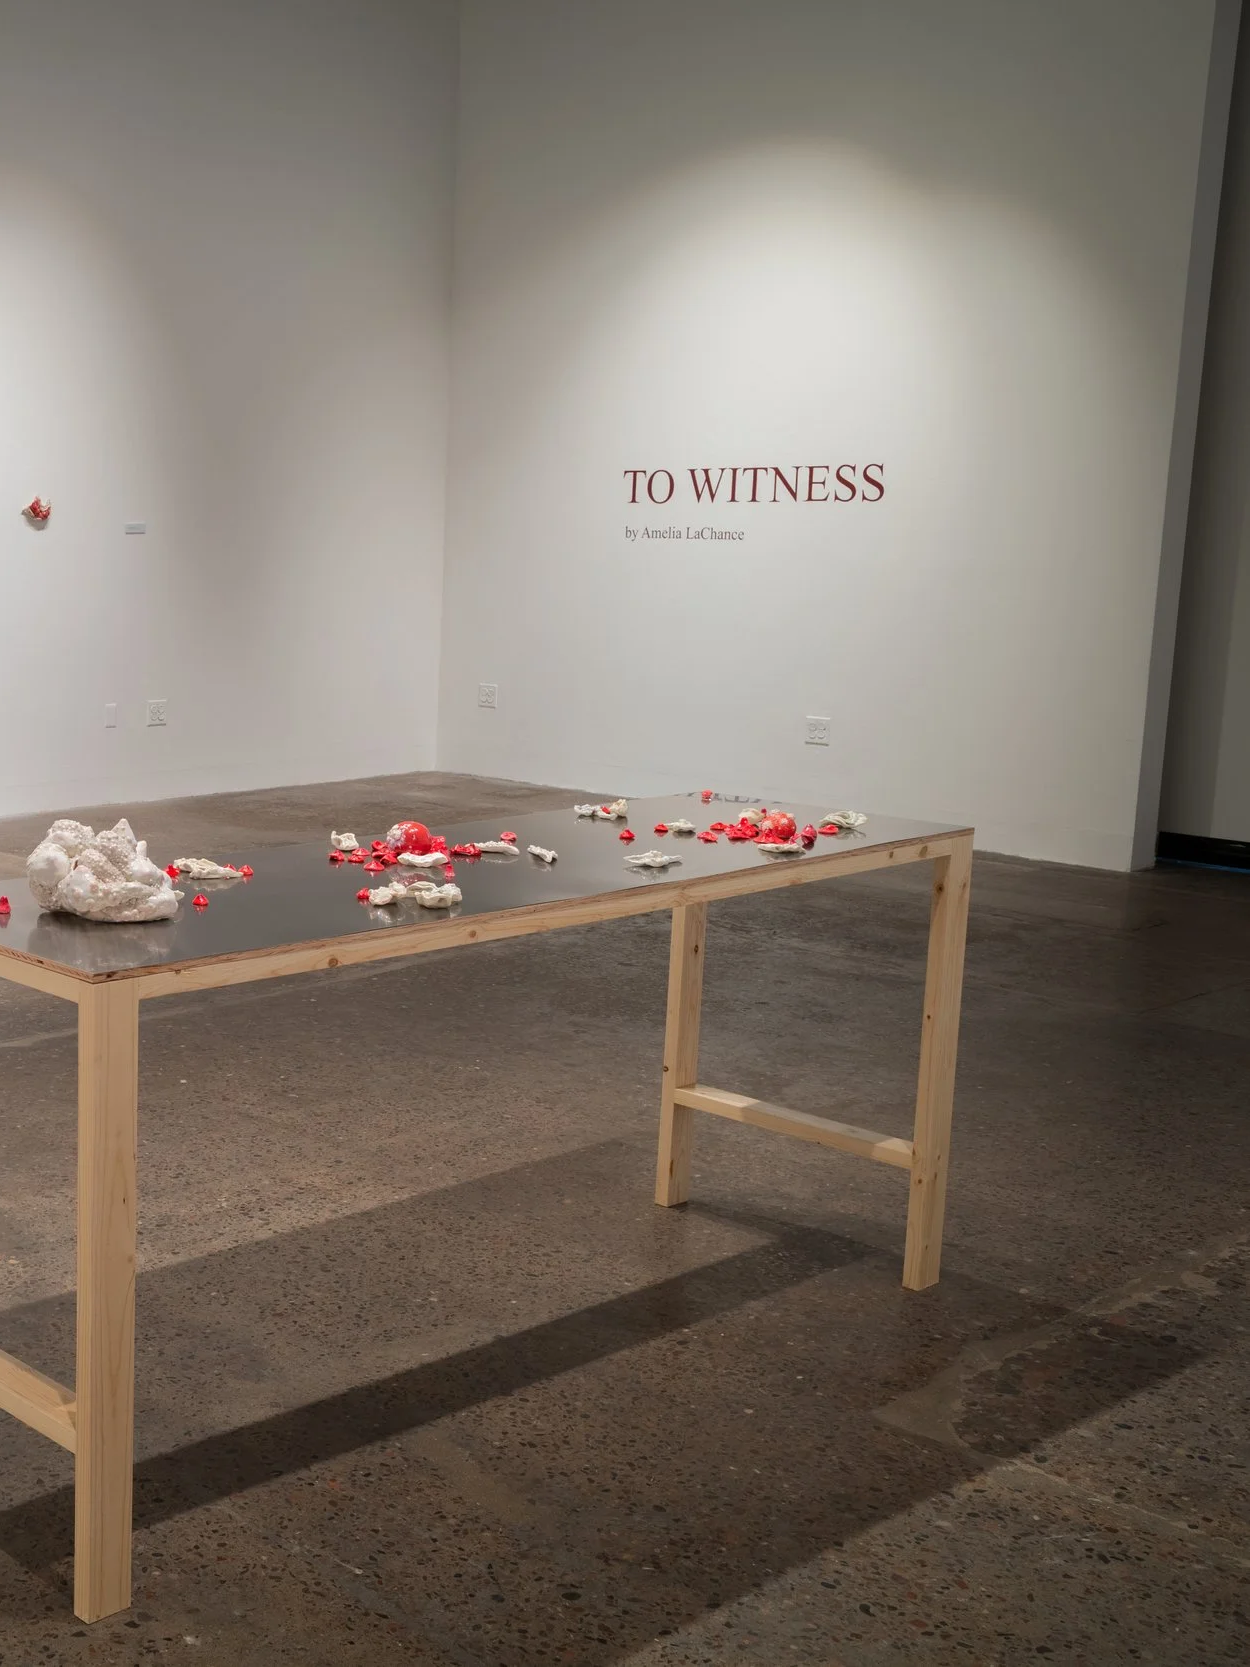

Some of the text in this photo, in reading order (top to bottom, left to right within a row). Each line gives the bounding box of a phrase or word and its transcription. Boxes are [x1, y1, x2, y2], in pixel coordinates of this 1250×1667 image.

[623, 463, 885, 504] TO WITNESS
[625, 525, 745, 541] by Amelia LaChance
